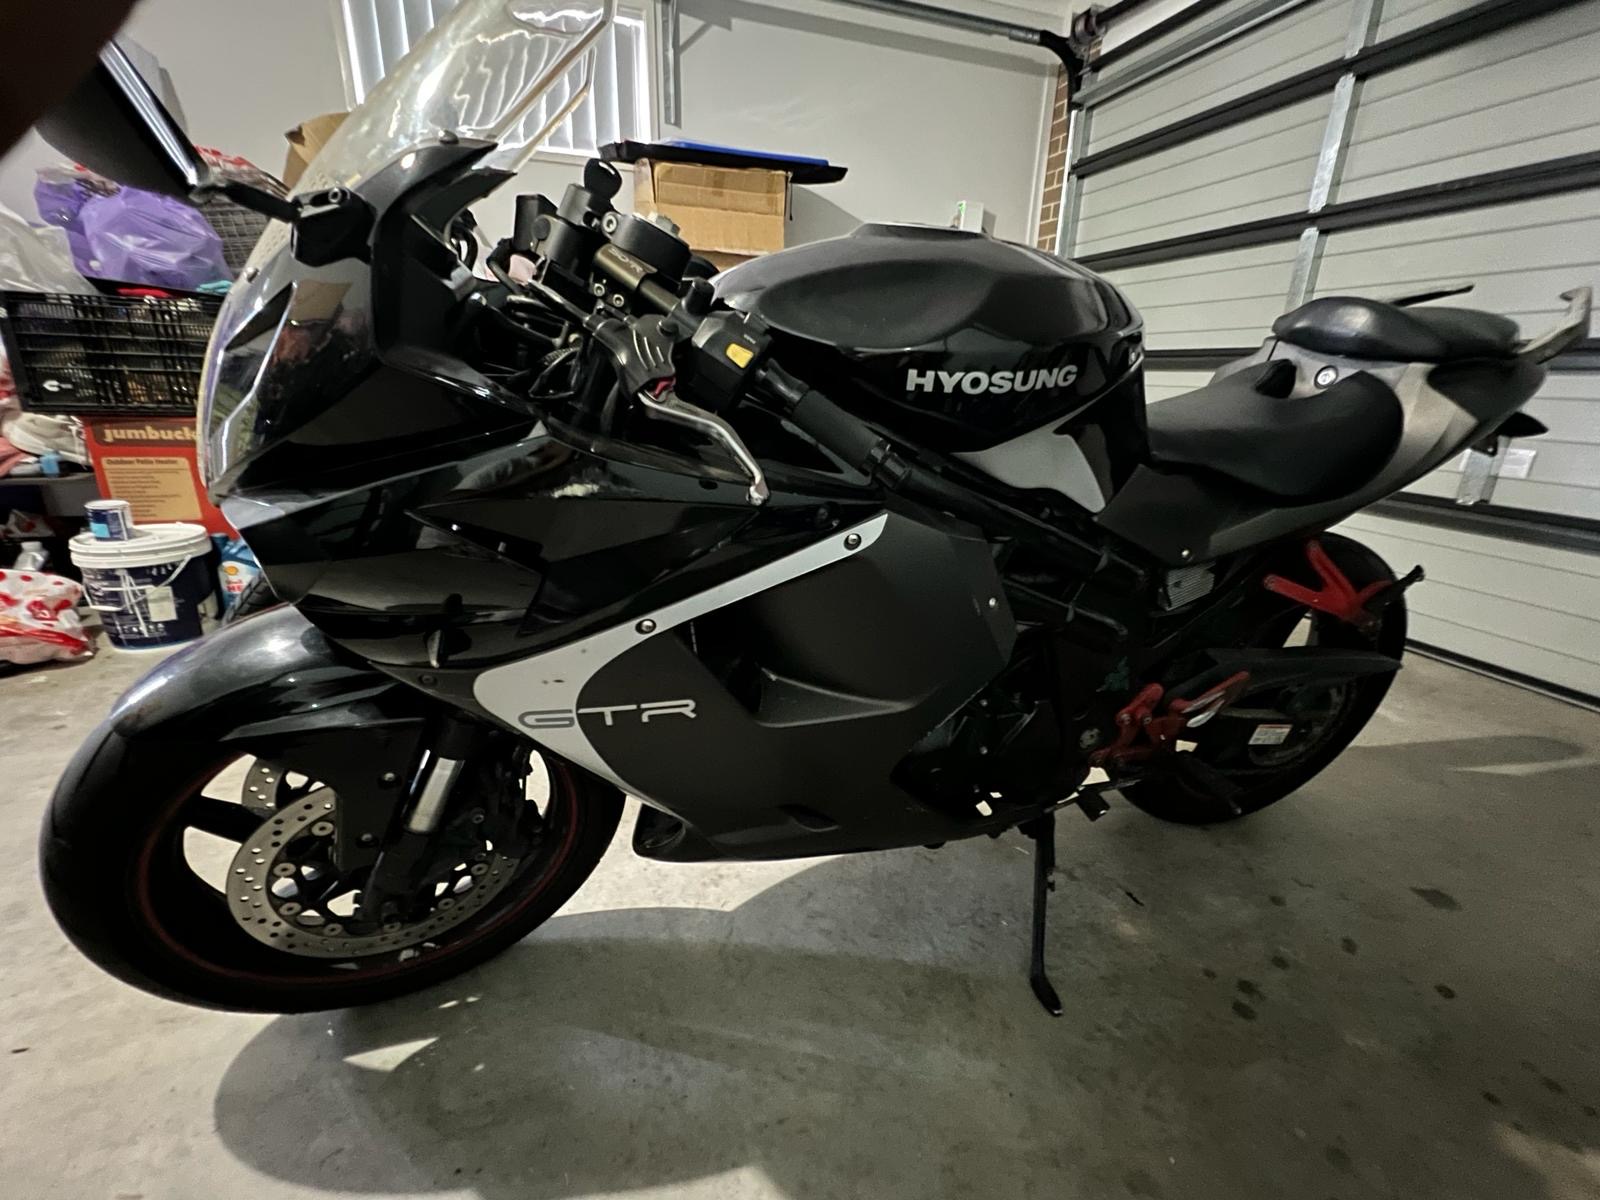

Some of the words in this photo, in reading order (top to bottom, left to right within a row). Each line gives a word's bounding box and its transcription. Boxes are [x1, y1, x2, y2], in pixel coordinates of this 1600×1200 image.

[905, 364, 1079, 395] HYOSUNG
[103, 425, 197, 443] jumbuck
[517, 698, 698, 730] GTR
